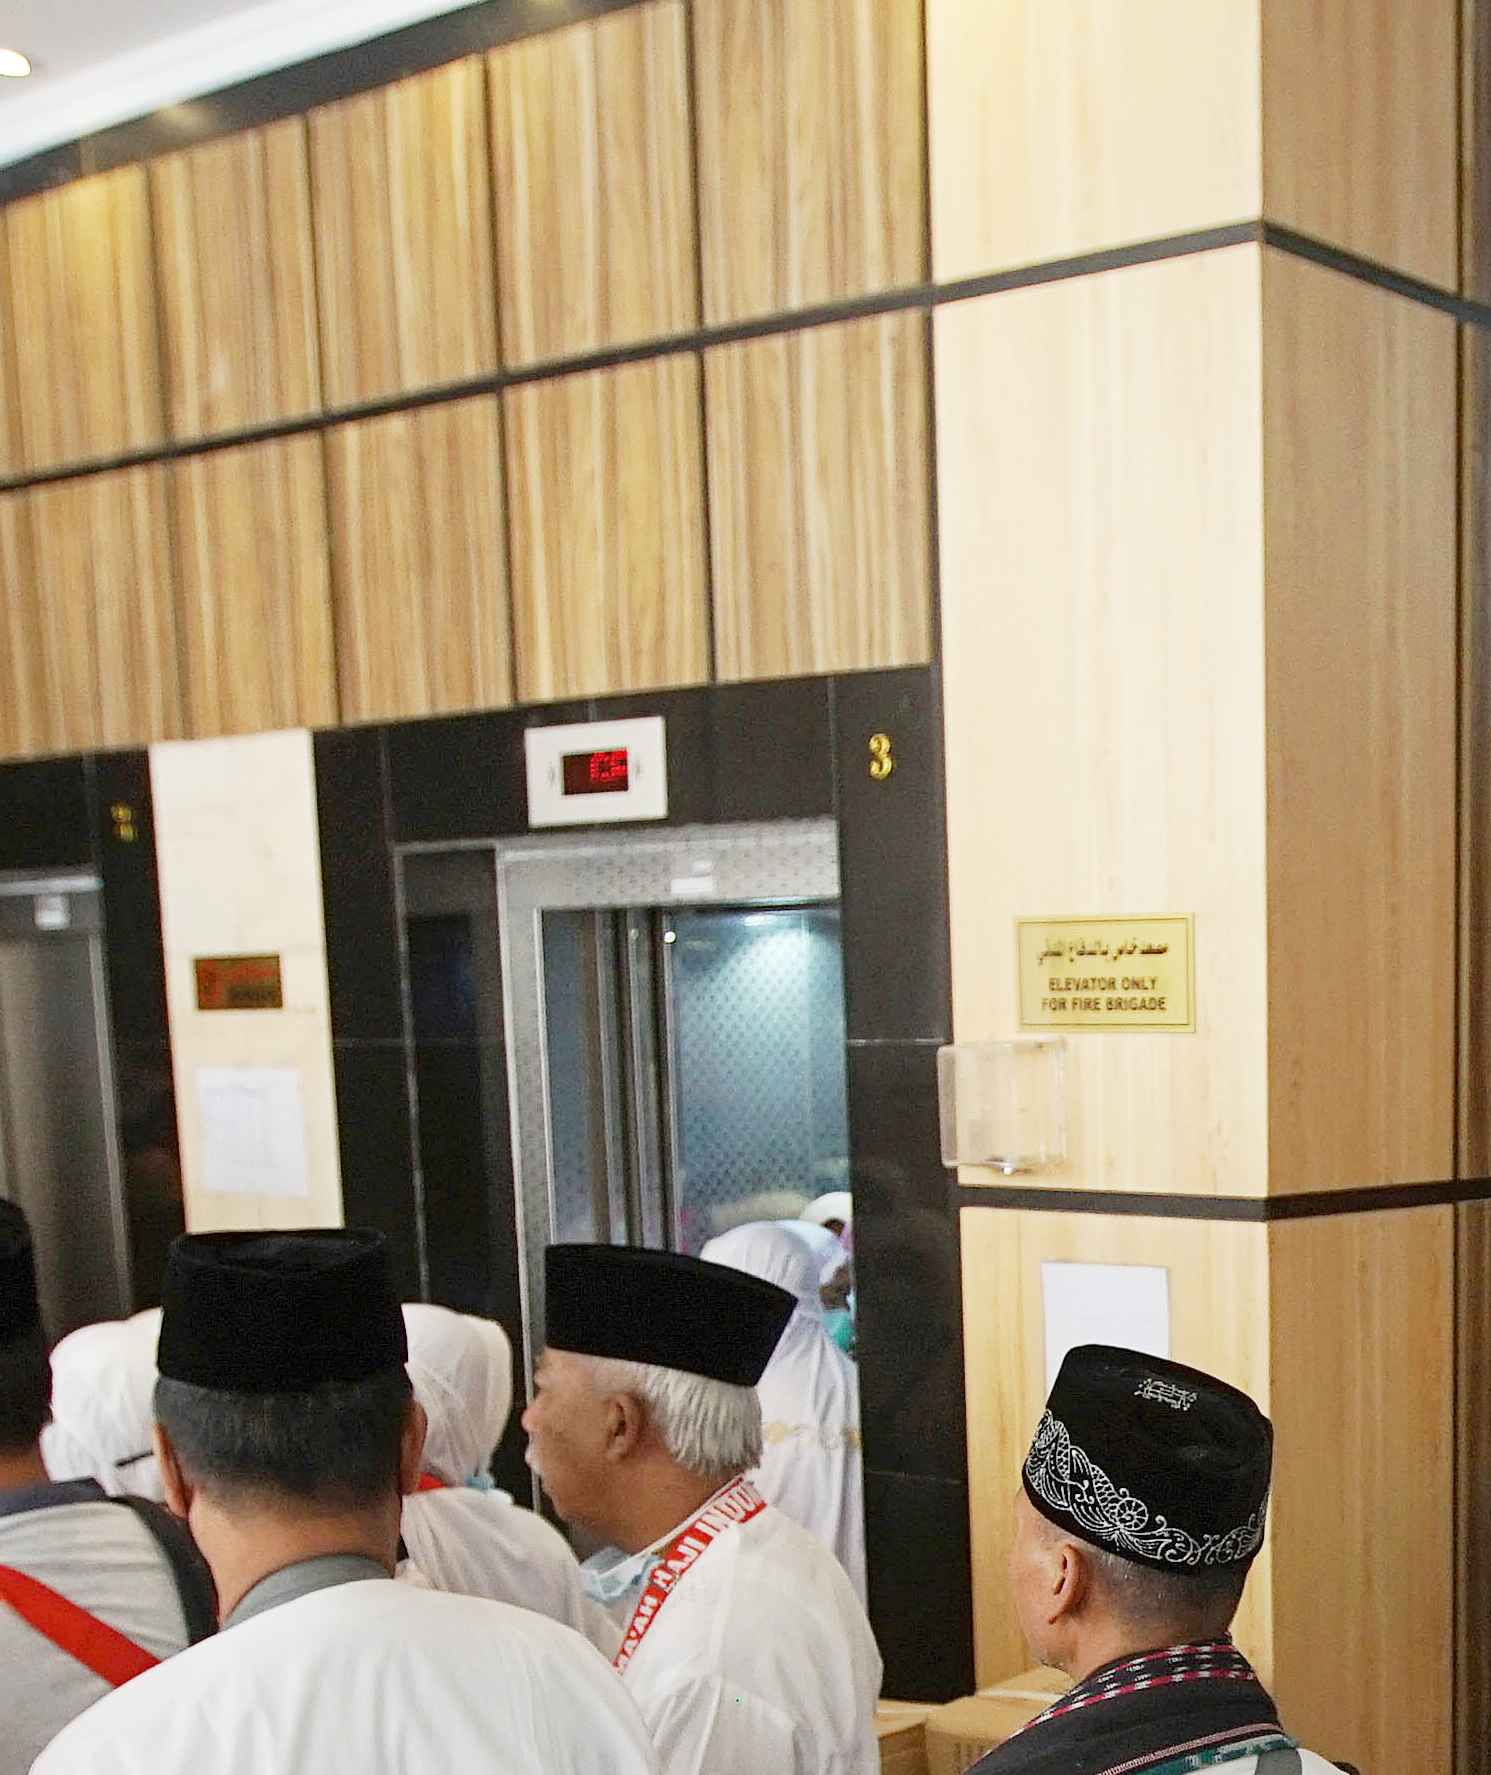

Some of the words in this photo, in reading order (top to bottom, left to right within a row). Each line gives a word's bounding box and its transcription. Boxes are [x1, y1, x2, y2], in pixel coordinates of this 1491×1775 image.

[870, 734, 892, 779] 3
[1048, 976, 1117, 991] ELEVATOR
[1121, 975, 1158, 991] ONLY
[1041, 997, 1067, 1011] FOR
[1072, 997, 1101, 1011] FIRE
[1105, 996, 1167, 1011] BRIGADE
[651, 1535, 709, 1592] HAJI
